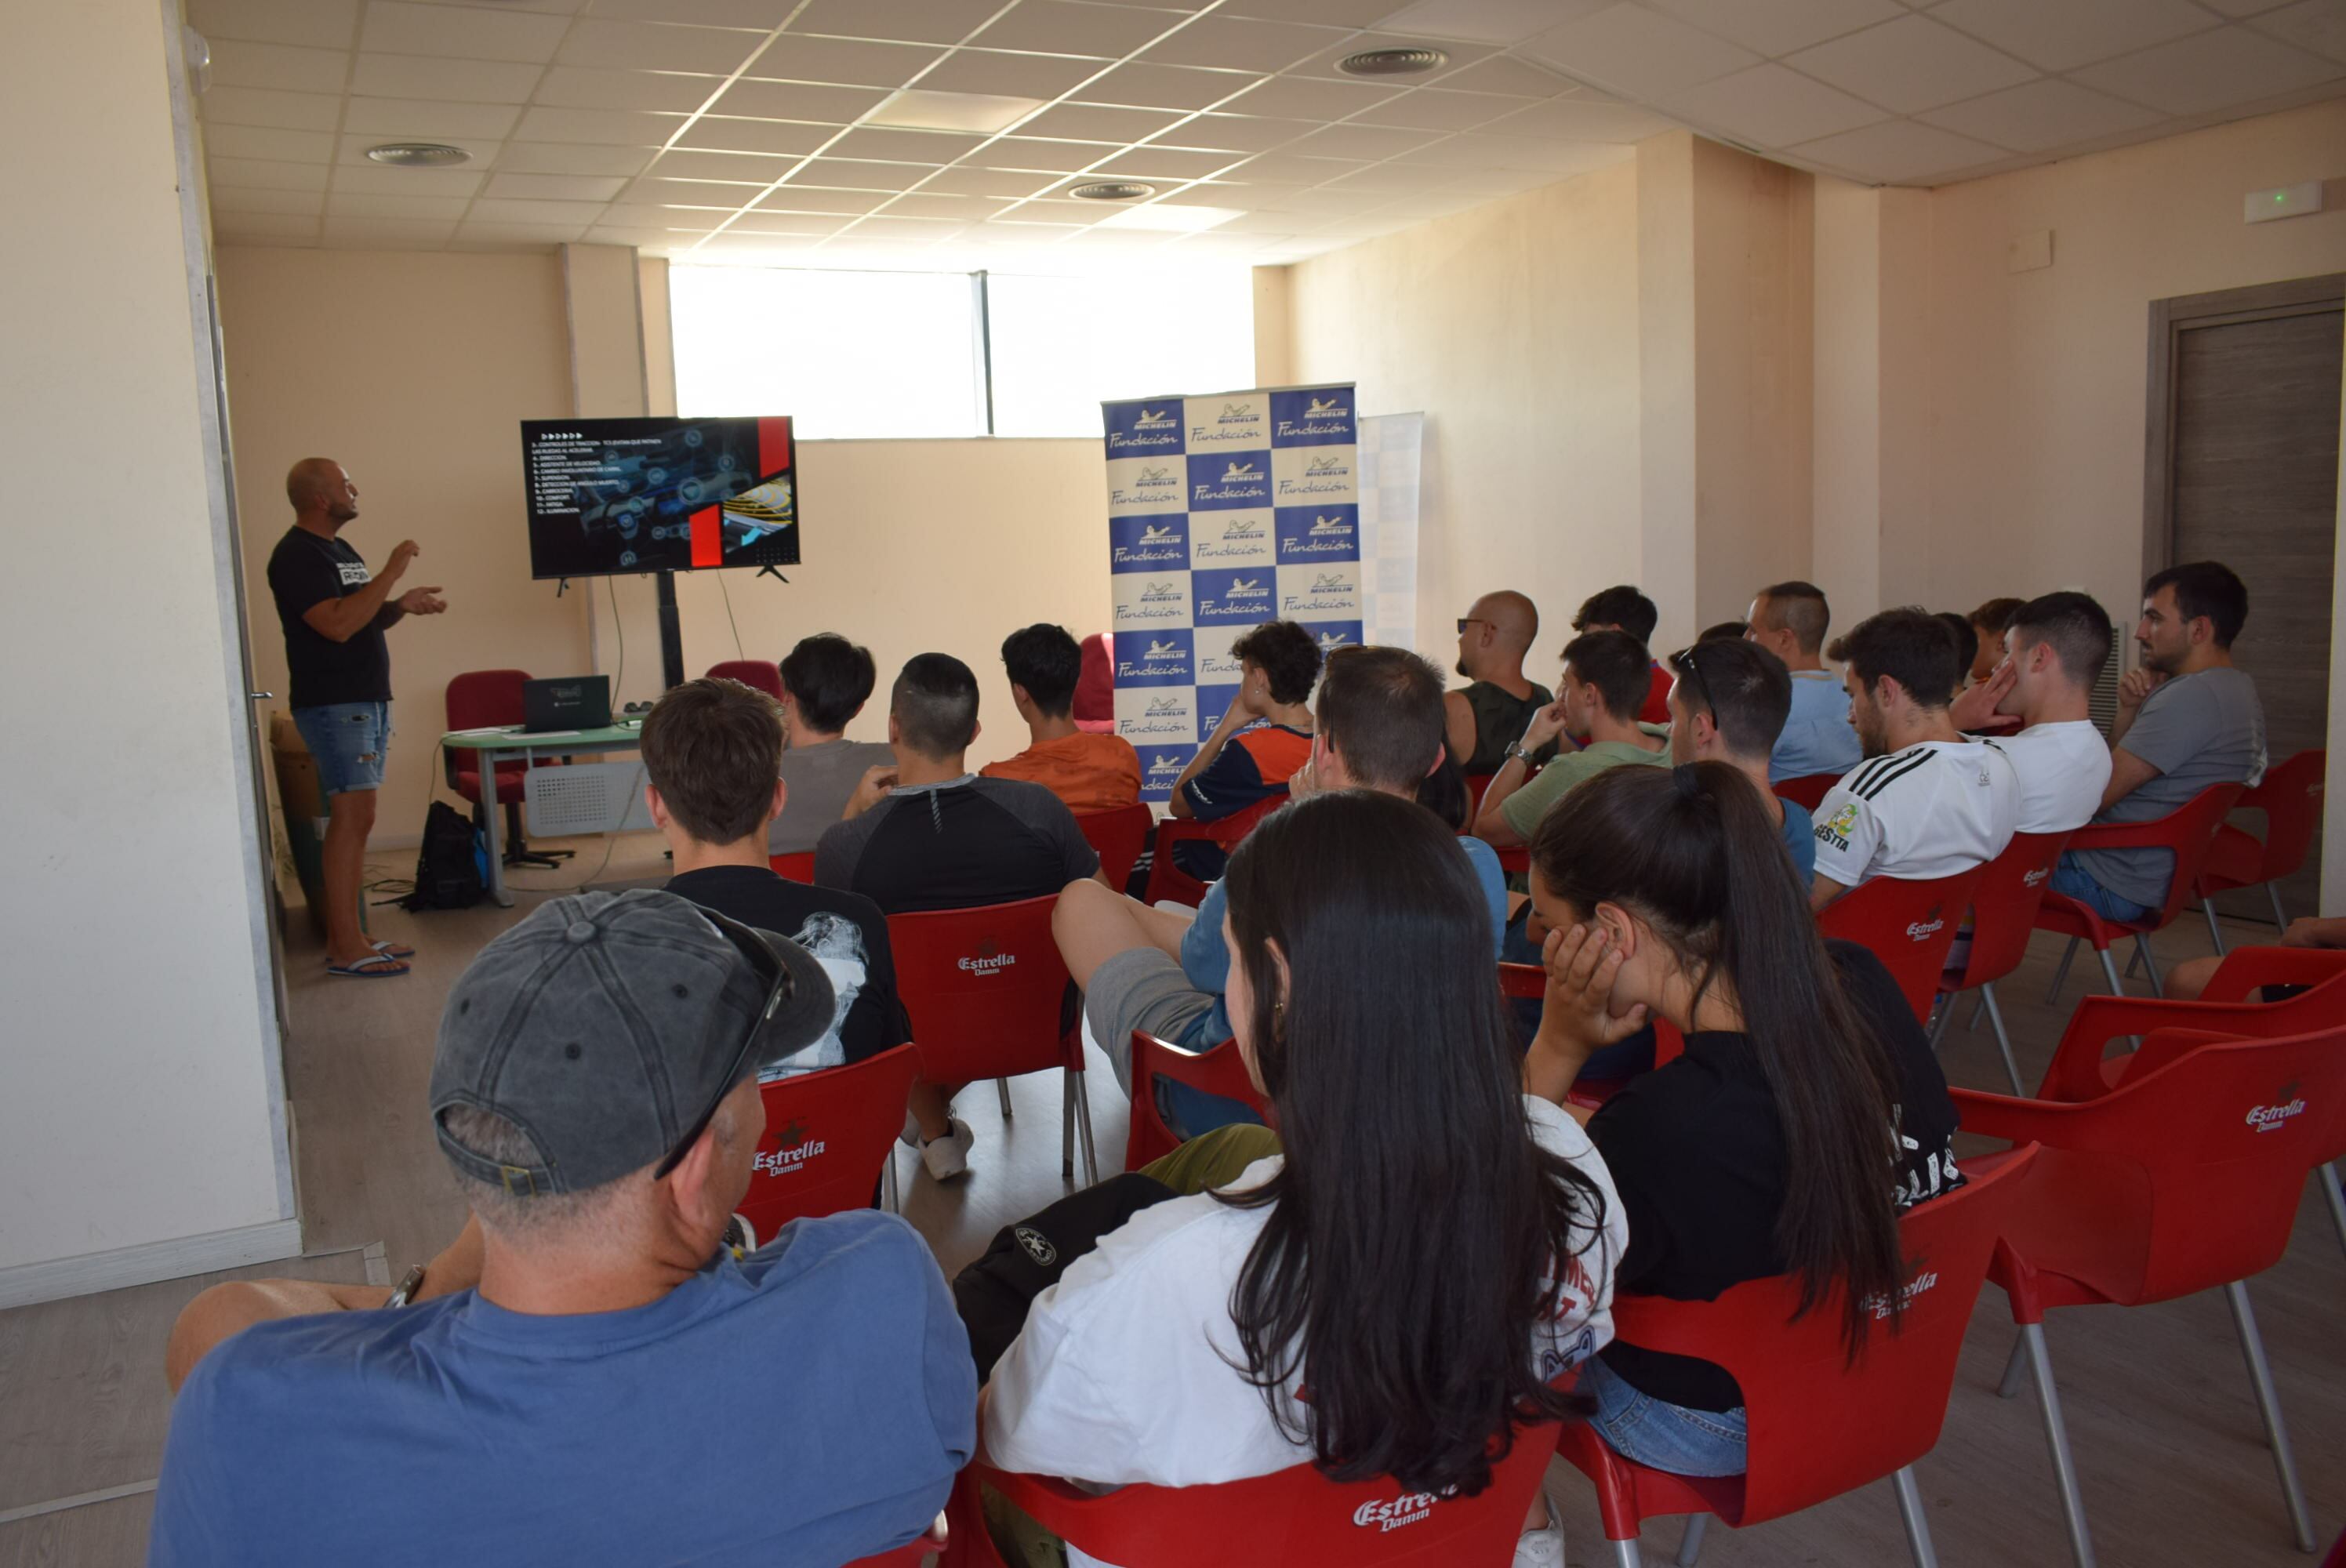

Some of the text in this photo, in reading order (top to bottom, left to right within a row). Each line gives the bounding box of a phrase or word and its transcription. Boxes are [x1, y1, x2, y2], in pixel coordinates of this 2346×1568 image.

[1134, 421, 1176, 430] MICHELIN
[1277, 421, 1349, 436] Fundación
[1109, 433, 1178, 448] Fundación
[1191, 427, 1261, 442] Fundación
[1221, 474, 1264, 482] MICHELIN
[1306, 468, 1348, 477] MICHELIN
[1194, 485, 1265, 500] Fundación
[1280, 481, 1349, 495] Fundación
[1111, 491, 1178, 505] Fundación
[1138, 536, 1182, 545] MICHELIN
[1222, 532, 1266, 540] MICHELIN
[1197, 543, 1266, 558] Fundación
[1282, 538, 1353, 553] Fundación
[1114, 548, 1182, 563] Fundación
[1226, 590, 1269, 598] MICHELIN
[1117, 605, 1184, 619] Fundación
[1200, 601, 1269, 615] Fundación
[1284, 597, 1354, 612] Fundación
[1144, 652, 1186, 660] MICHELIN
[1119, 662, 1187, 677] Fundación
[1200, 659, 1243, 673] Funda
[1145, 709, 1187, 717] MICHELIN
[1120, 720, 1189, 735] Fundación
[1814, 823, 1850, 852] GESTTA
[958, 953, 1015, 971] Estrella
[2246, 1098, 2305, 1125] Estrella
[753, 1140, 825, 1171] Estrella
[769, 1162, 804, 1177] Damm
[1379, 1508, 1430, 1532] Damm
